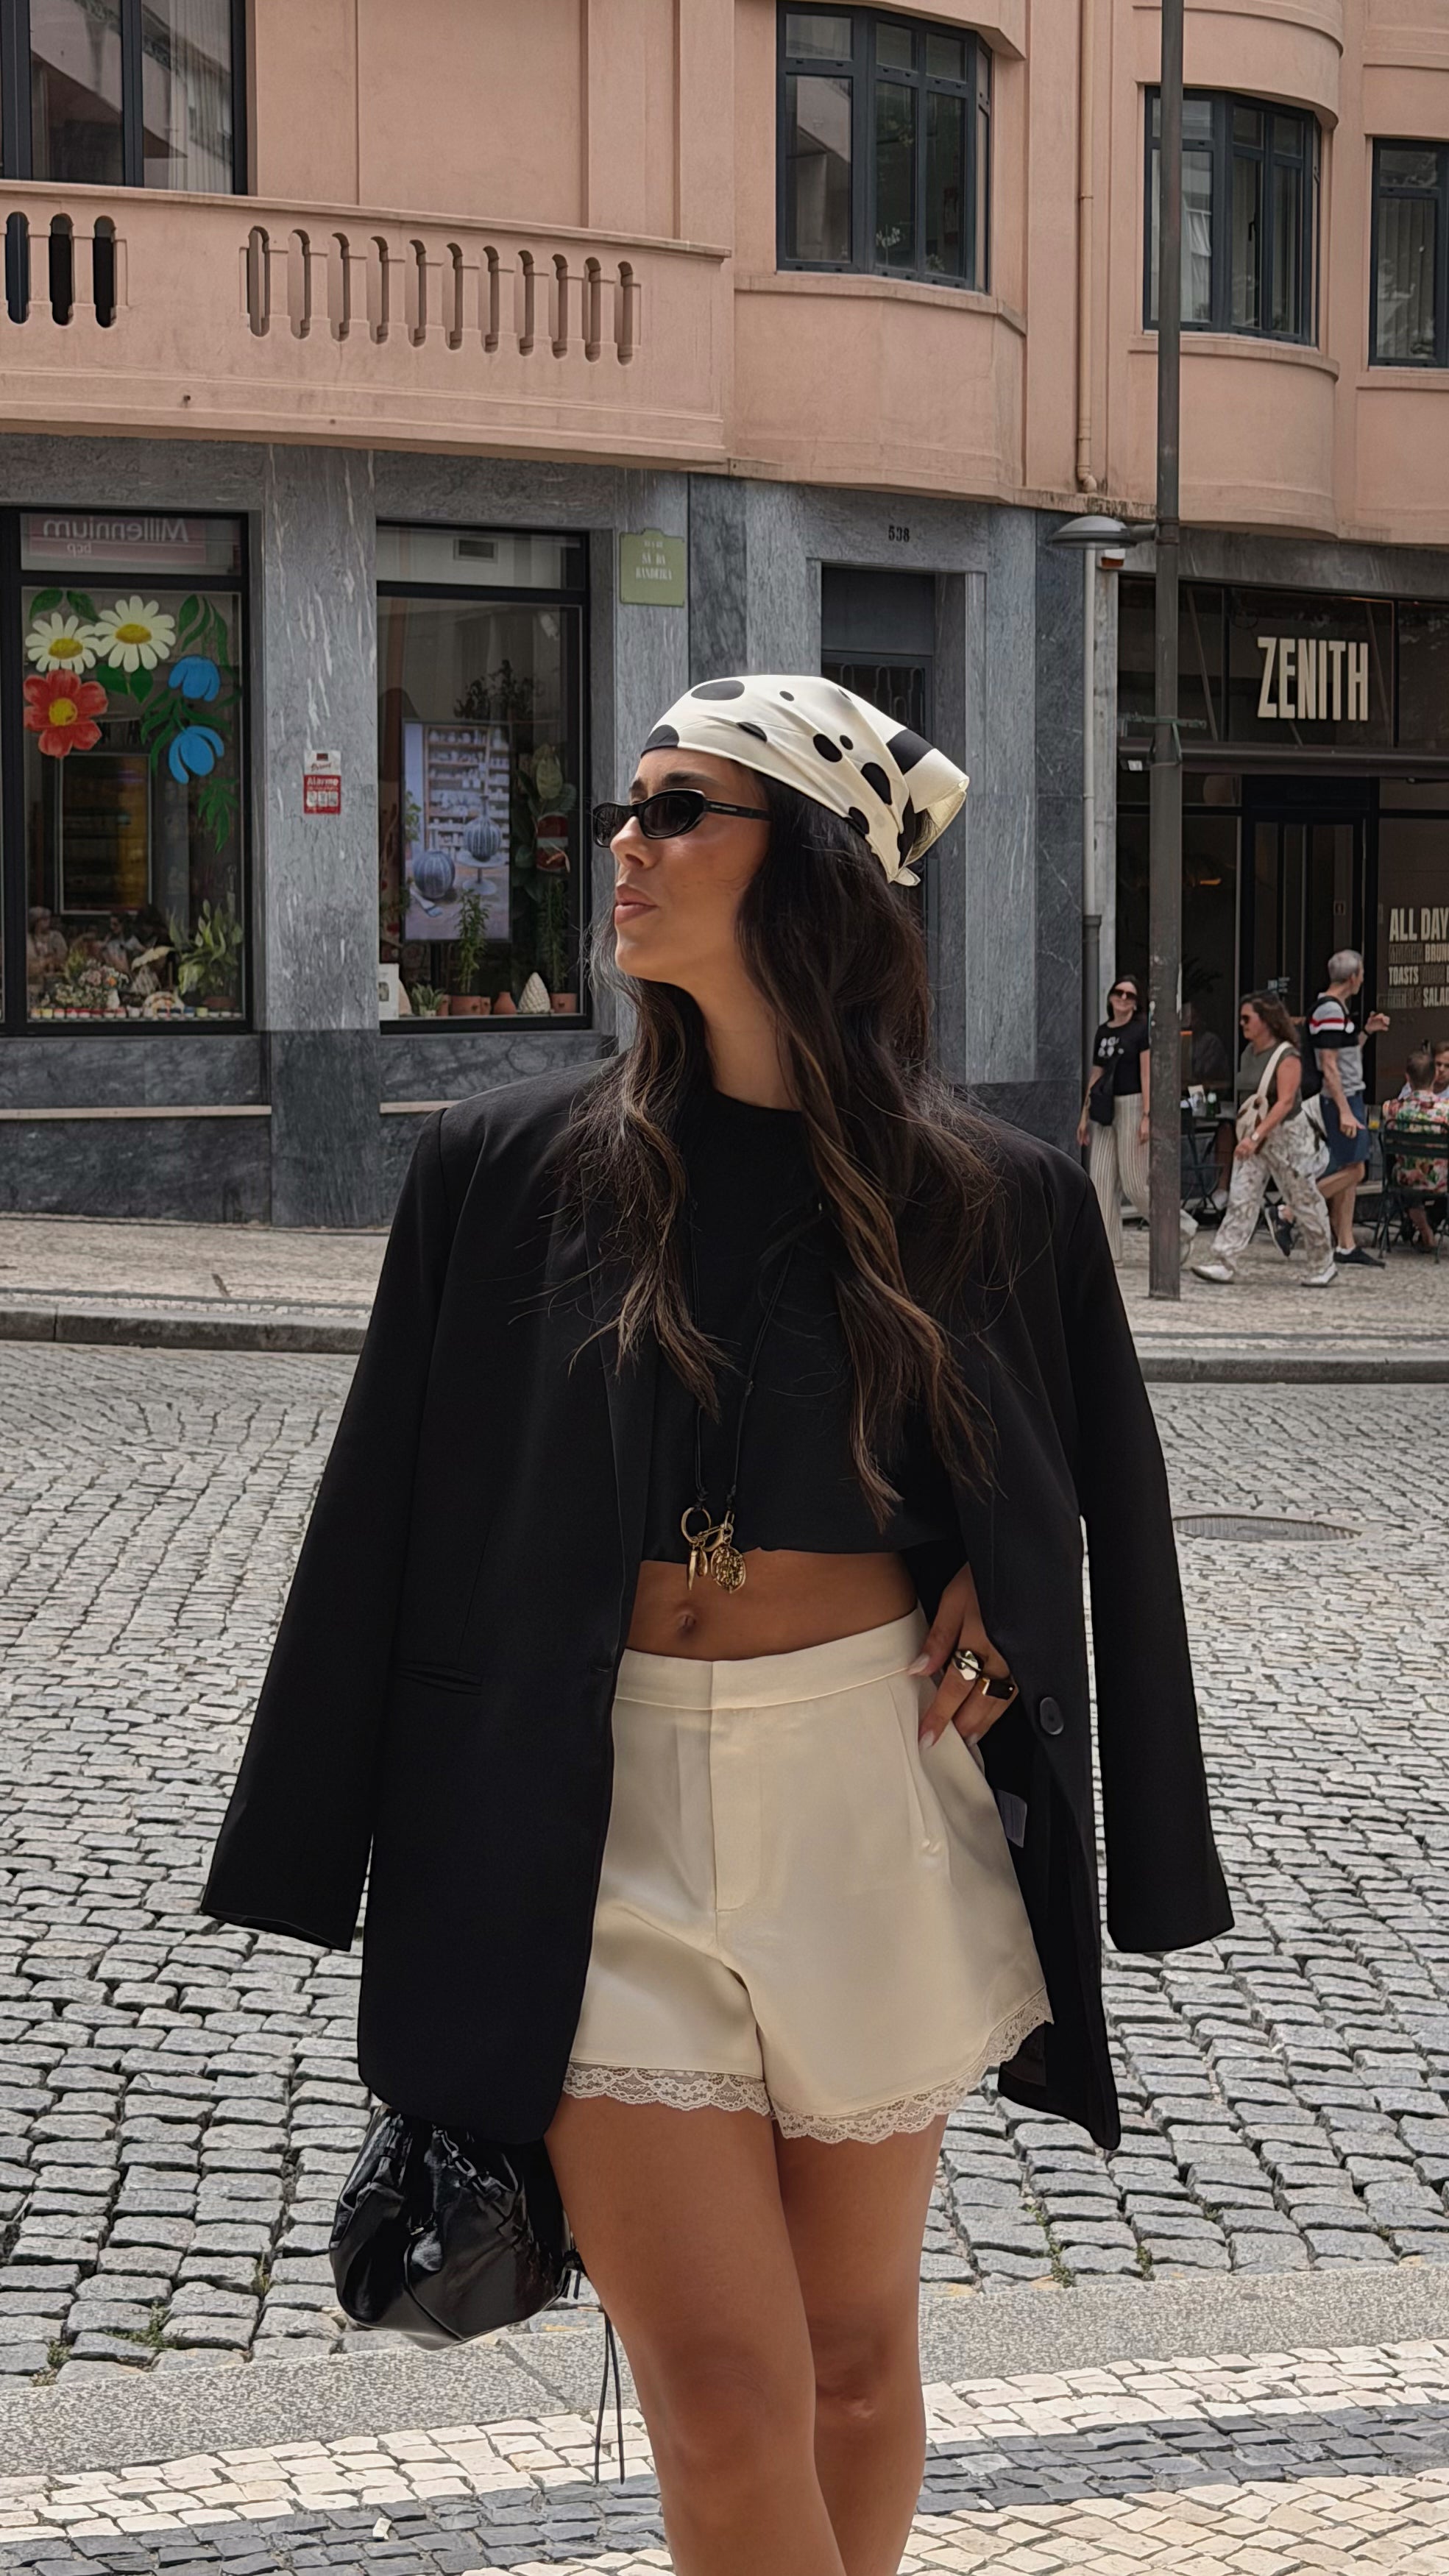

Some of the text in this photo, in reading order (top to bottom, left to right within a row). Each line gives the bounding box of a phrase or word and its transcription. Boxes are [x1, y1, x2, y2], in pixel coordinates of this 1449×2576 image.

[888, 525, 910, 542] 538
[1257, 636, 1369, 722] ZENITH
[1389, 906, 1449, 942] ALL DAY
[1389, 966, 1420, 986] TOASTS
